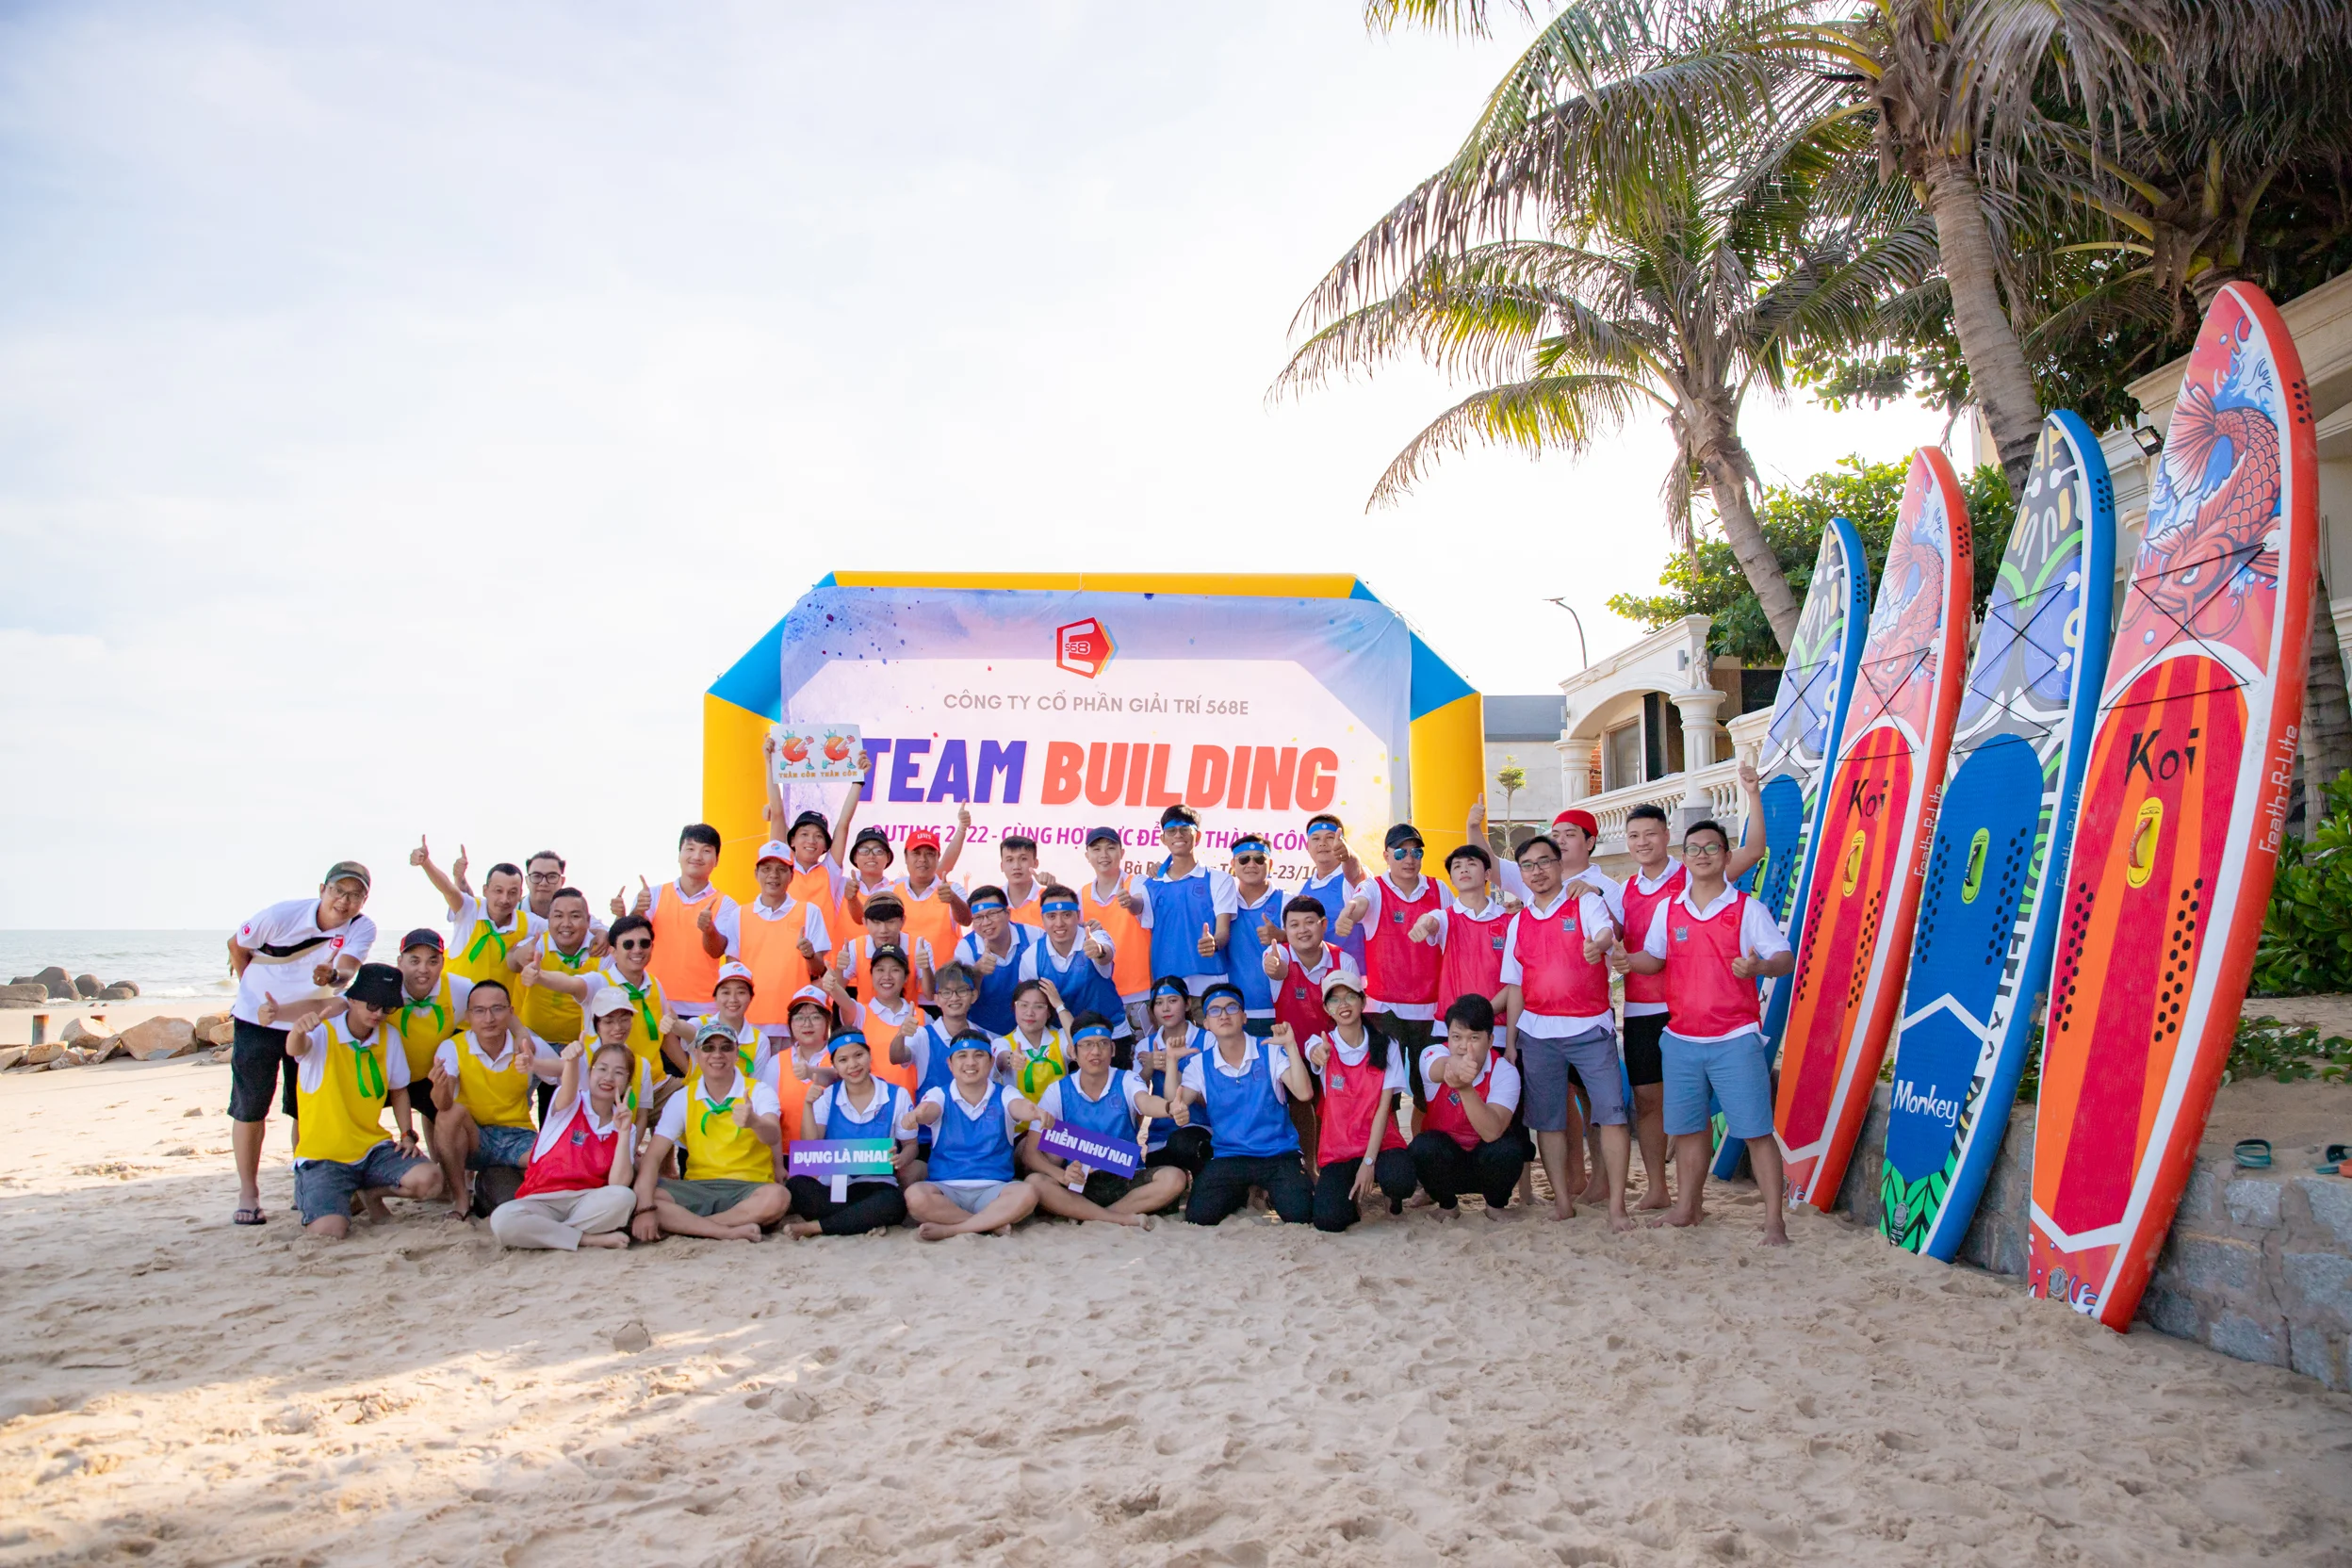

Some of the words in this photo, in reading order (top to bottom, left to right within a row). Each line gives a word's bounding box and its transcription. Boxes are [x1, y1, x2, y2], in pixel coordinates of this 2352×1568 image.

[1065, 642, 1089, 654] 568
[943, 689, 1003, 710] CÔNG
[1007, 695, 1031, 710] TY
[1037, 690, 1068, 711] CỔ
[1073, 691, 1122, 712] PHẦN
[1129, 693, 1168, 713] GIẢI
[1174, 694, 1202, 714] TRÍ
[1205, 700, 1249, 715] 568E
[861, 738, 1028, 804] TEAM
[1040, 741, 1339, 810] BUILDING
[2124, 727, 2200, 787] Koi
[1846, 778, 1889, 819] Koi
[2258, 725, 2298, 855] Feath-R-Lite
[944, 825, 988, 843] 222
[1124, 860, 1143, 874] Bà
[1892, 1080, 1959, 1128] Monkey
[793, 1151, 833, 1168] ĐỤNG
[834, 1148, 852, 1164] LÀ
[853, 1150, 890, 1164] NHAI
[1044, 1128, 1079, 1150] HIỀN
[1077, 1139, 1110, 1159] NHƯ
[1107, 1148, 1134, 1168] NAI
